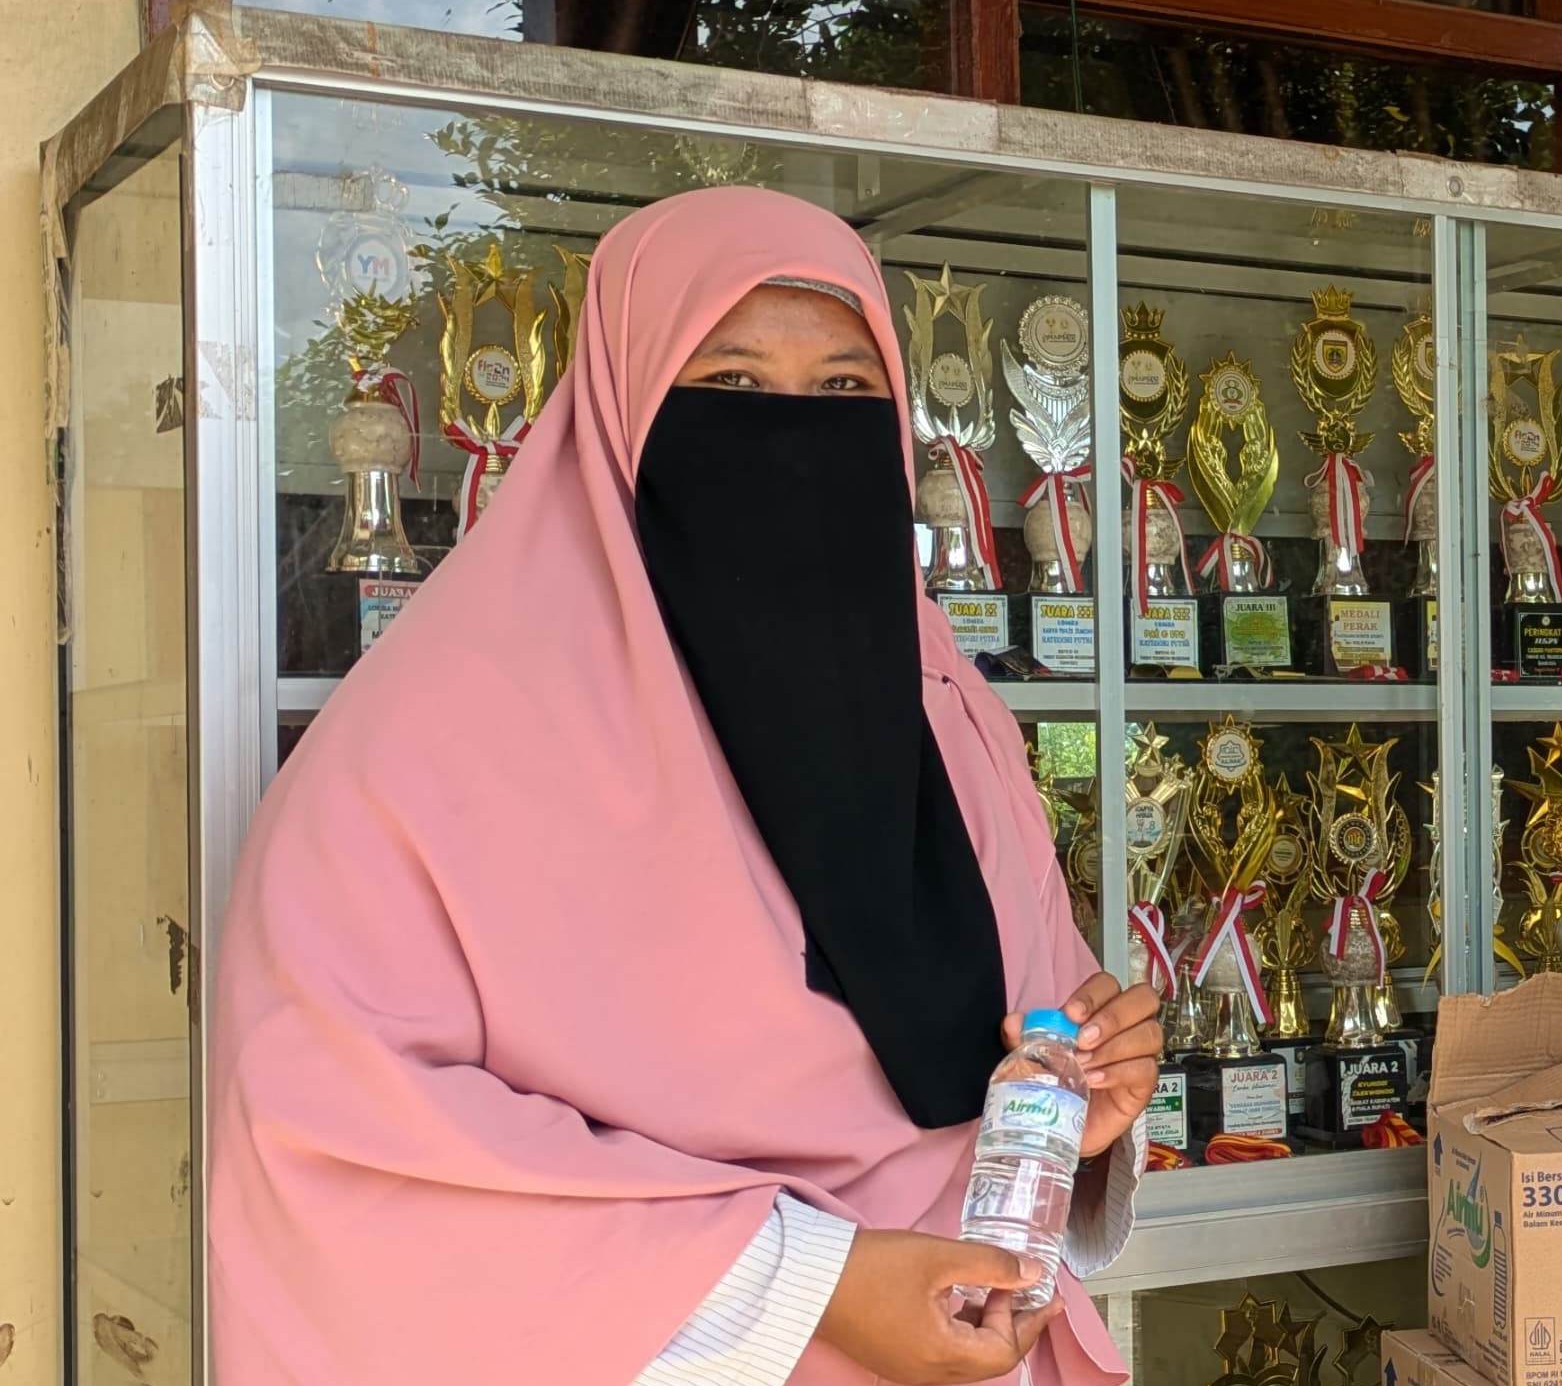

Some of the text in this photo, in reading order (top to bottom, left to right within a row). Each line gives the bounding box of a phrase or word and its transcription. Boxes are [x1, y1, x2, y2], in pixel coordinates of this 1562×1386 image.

[948, 602, 982, 617] JUARA
[1040, 604, 1075, 619] JUARA
[1235, 603, 1264, 613] JUARA
[1340, 609, 1380, 619] MEDALI
[1343, 621, 1379, 631] PERAK
[1523, 627, 1562, 637] PERINGKAT
[1348, 1060, 1399, 1075] JUARA 2
[1230, 1069, 1278, 1083] JUARA 2
[1171, 1082, 1178, 1093] 2
[1003, 1098, 1053, 1116] Airmu
[1520, 1172, 1533, 1183] Isi
